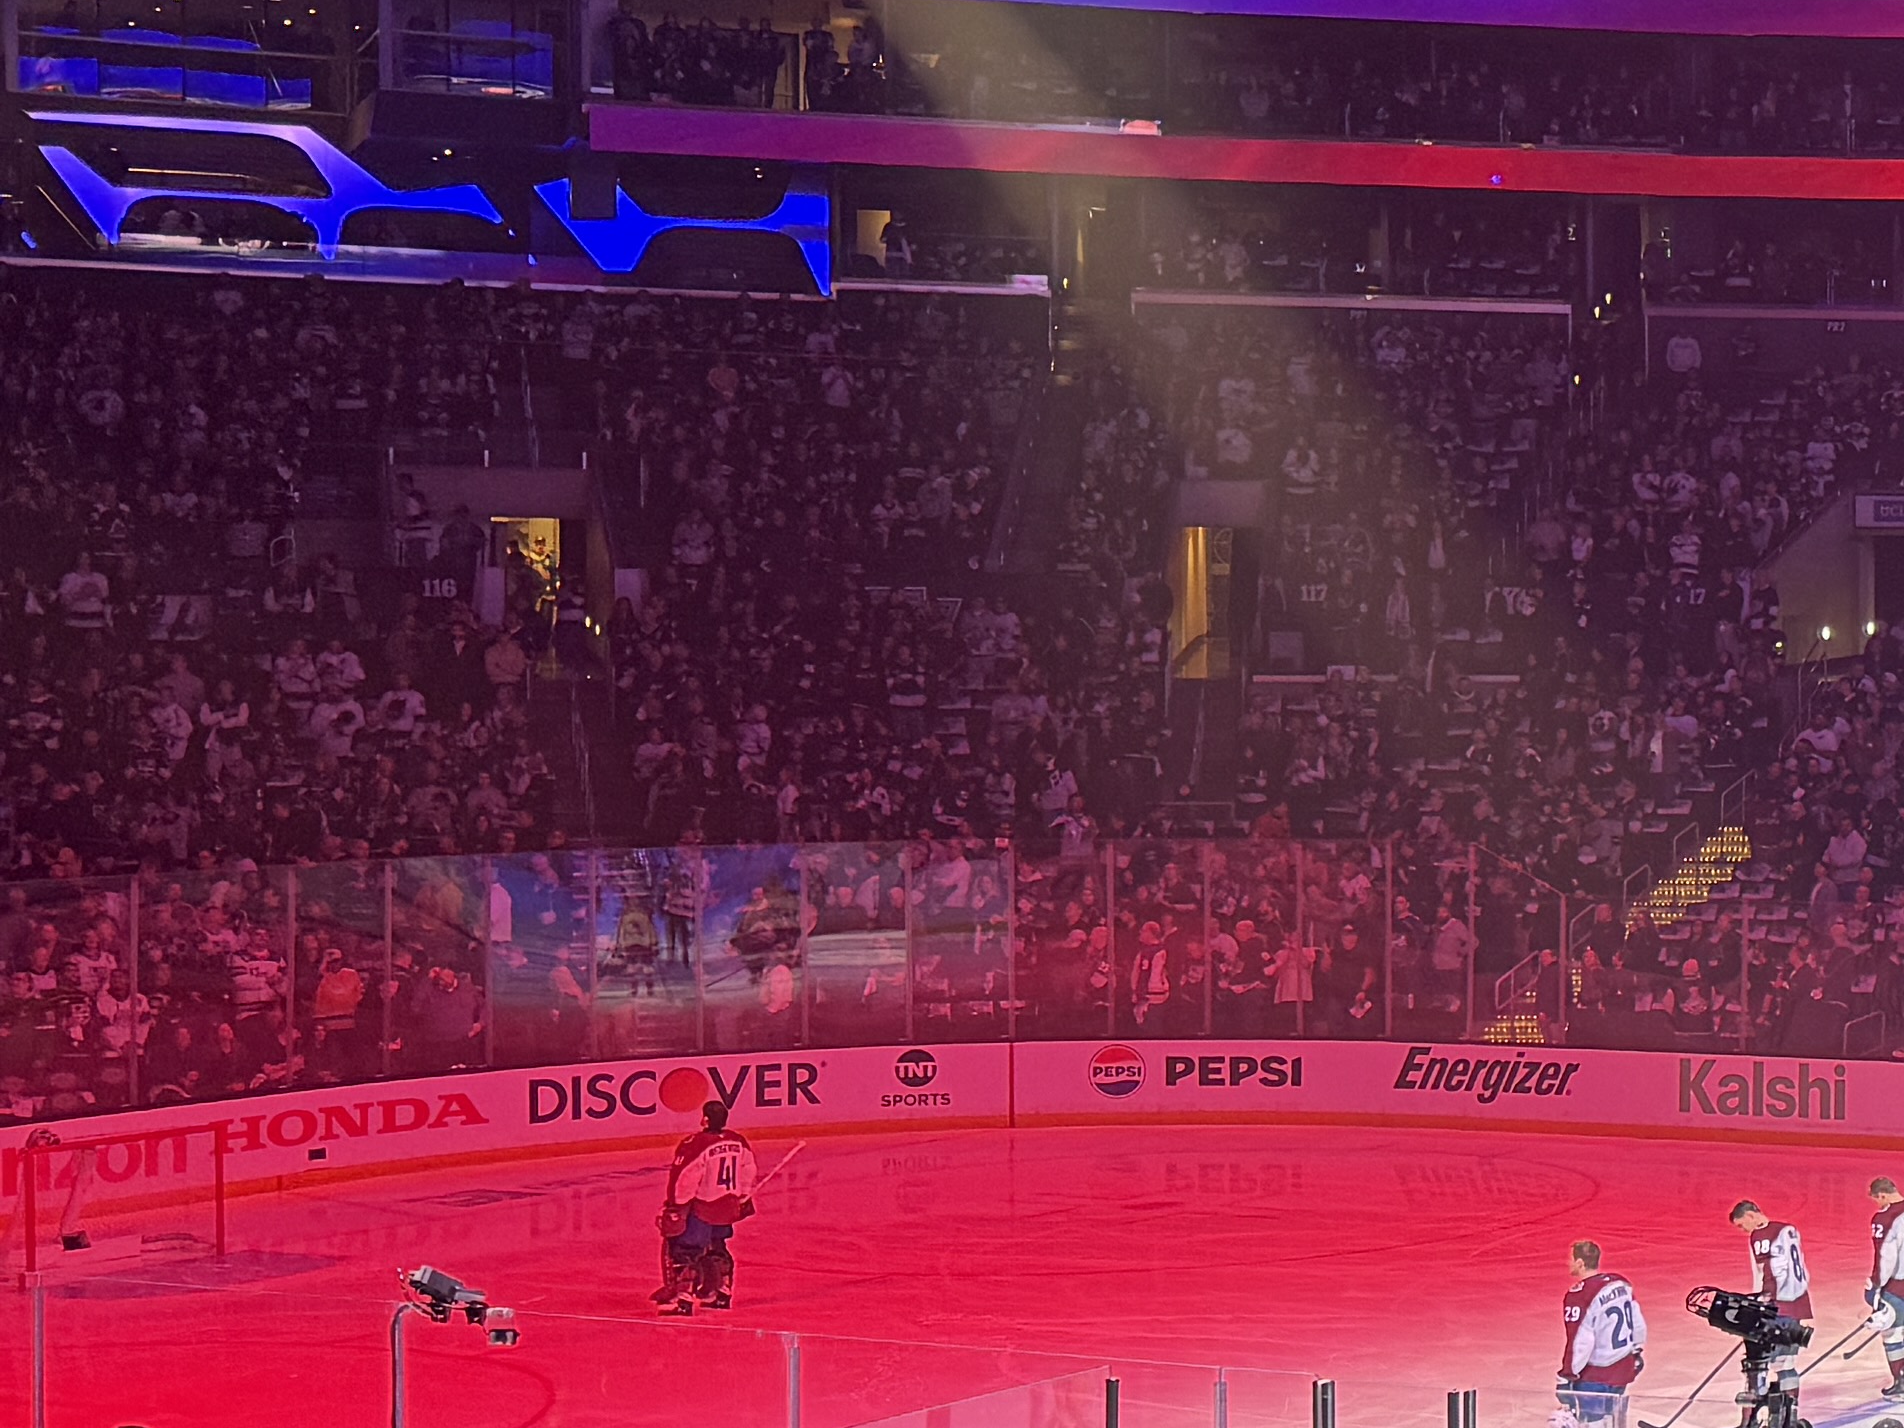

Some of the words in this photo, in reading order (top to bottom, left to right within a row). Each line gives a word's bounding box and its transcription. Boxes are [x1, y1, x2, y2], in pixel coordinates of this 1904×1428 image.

[421, 577, 457, 599] 116
[1300, 584, 1329, 602] 117
[896, 1060, 939, 1080] TNT
[1091, 1065, 1143, 1080] PEPSI
[1165, 1055, 1303, 1088] PEPSI
[1393, 1046, 1581, 1104] Energizer
[528, 1062, 822, 1124] DISCOVER
[880, 1092, 952, 1108] SPORTS
[1677, 1058, 1847, 1121] Kalshi
[222, 1092, 490, 1154] HONDA
[717, 1154, 737, 1191] 41
[1563, 1306, 1581, 1322] 29
[1605, 1299, 1633, 1350] 29
